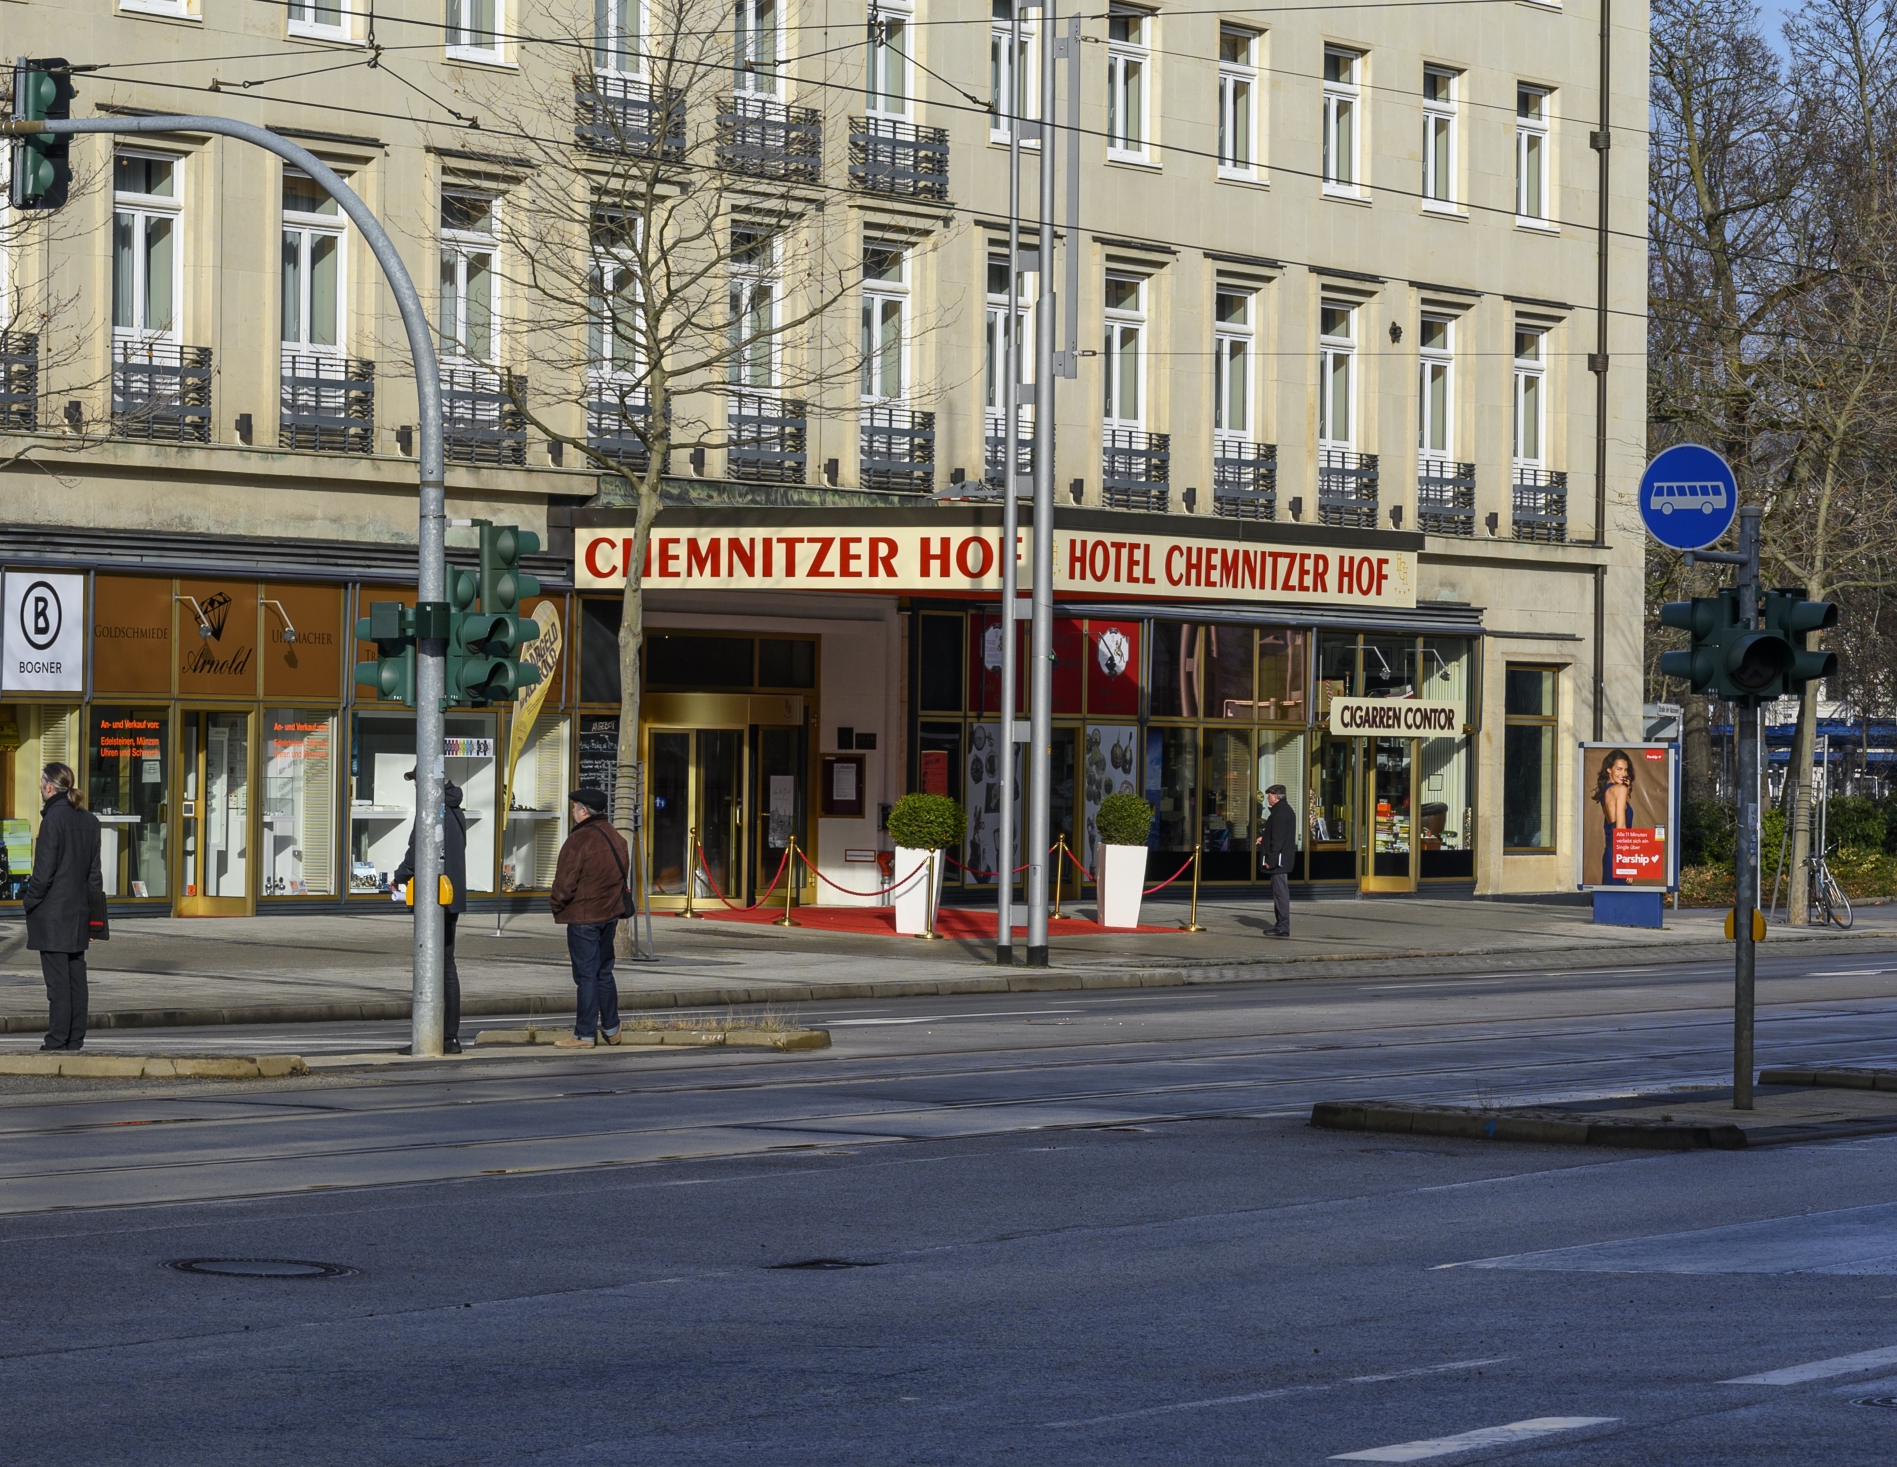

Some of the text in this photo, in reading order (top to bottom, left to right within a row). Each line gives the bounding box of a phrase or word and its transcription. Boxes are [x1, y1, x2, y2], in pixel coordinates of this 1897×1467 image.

[1069, 538, 1390, 597] HOTEL CHEMNITZER HOF
[94, 624, 168, 639] GOLDSCHMIEDE
[182, 645, 253, 675] Arnold
[19, 661, 62, 674] BOGNER
[101, 720, 111, 729] An-
[113, 720, 123, 729] und
[124, 720, 146, 729] Verkauf
[1340, 705, 1455, 730] CIGARREN CONTOR
[101, 747, 118, 757] Uhren
[120, 748, 131, 757] und
[1616, 853, 1650, 866] Parship
